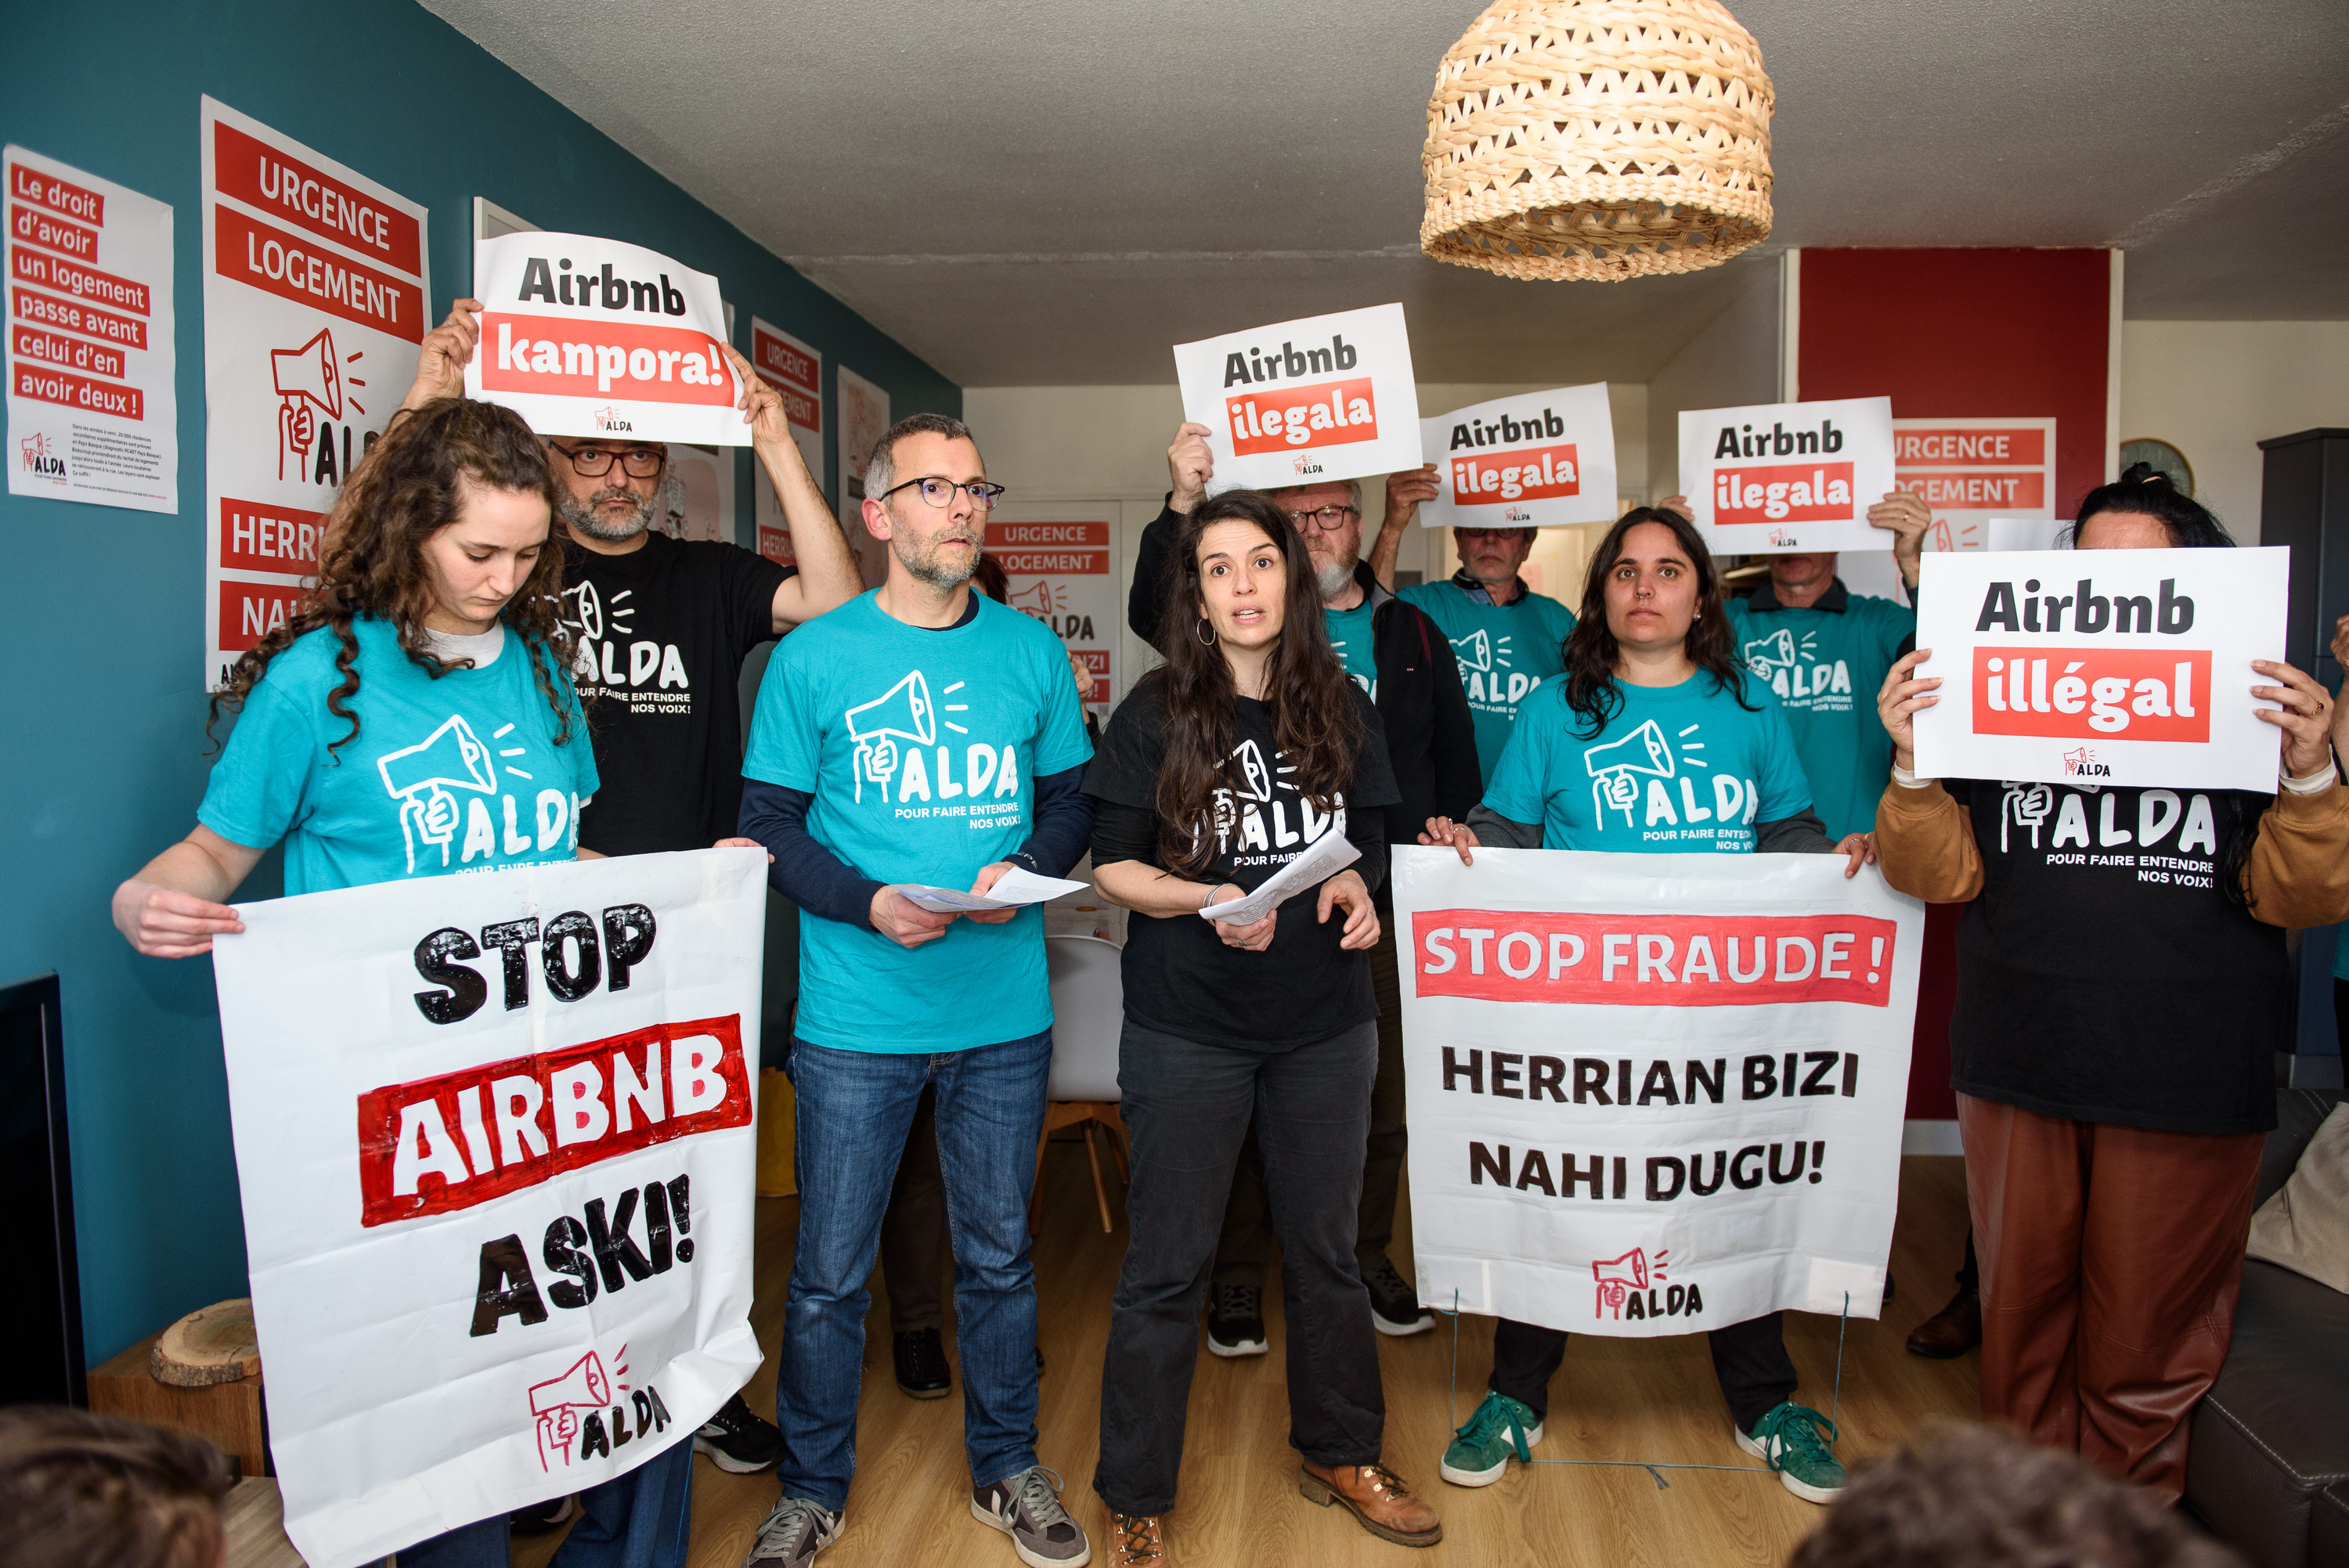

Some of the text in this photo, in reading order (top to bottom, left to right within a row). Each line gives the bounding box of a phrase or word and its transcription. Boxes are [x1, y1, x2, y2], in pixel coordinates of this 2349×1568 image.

[18, 171, 96, 219] Le droit
[259, 156, 389, 251] URGENCE
[18, 212, 90, 254] d'avoir
[20, 255, 144, 308] un logement
[247, 232, 400, 323] LOGEMENT
[518, 257, 686, 316] Airbnb
[20, 294, 139, 343] passe avant
[20, 335, 117, 373] celui d'en
[498, 323, 723, 391] kanpora!
[767, 341, 808, 381] URGENCE
[1224, 334, 1357, 388] Airbnb
[21, 374, 136, 414] avoir deux !
[770, 385, 811, 421] EMENT
[606, 420, 632, 431] ALDA
[1231, 388, 1373, 445] ilegala
[1450, 407, 1564, 451] Airbnb
[72, 447, 91, 456] Beaucoup
[1715, 419, 1842, 459] Airbnb
[35, 456, 66, 476] ALDA
[1303, 464, 1323, 474] ALDA
[1455, 452, 1576, 499] ilegala
[1717, 470, 1850, 519] ilegala
[1895, 479, 2019, 502] GEMENT
[763, 532, 794, 558] HERRI
[1005, 526, 1086, 542] URGENCE
[1777, 538, 1798, 546] ALDA
[1975, 578, 2194, 635] Airbnb
[572, 636, 688, 690] ALDA
[1073, 654, 1104, 669] IZI
[1771, 660, 1852, 698] ALDA
[575, 687, 691, 702] OUR FAIRE ENTENDRE
[631, 704, 691, 714] NOS VOIX!
[1812, 703, 1829, 712] NOS
[1813, 695, 1853, 704] ENTENDRE
[1987, 657, 2195, 733] illégal
[899, 743, 1018, 803] ALDA
[2077, 764, 2110, 777] ALDA
[895, 802, 1019, 819] POUR FAIRE ENTENDRE
[1646, 774, 1759, 827] ALDA
[970, 815, 1020, 829] NOS VOIX!
[1643, 831, 1677, 841] POUR
[1681, 829, 1715, 839] FAIRE
[2052, 789, 2216, 855] ALDA
[1234, 856, 1267, 867] POUR
[1716, 841, 1740, 850] NOS
[2046, 854, 2214, 873] POUR FAIRE ENTENDRE
[2138, 871, 2213, 888] NOS VOIX!
[413, 903, 655, 1025] STOP
[1423, 928, 1884, 985] STOP FRAUDE !
[1441, 1045, 1858, 1106] HERRIAN BIZI
[393, 1033, 727, 1197] AIRBNB
[1469, 1141, 1825, 1201] NAHI DUGU!
[469, 1174, 695, 1337] ASKI!
[1626, 1283, 1703, 1320] ALDA
[580, 1386, 671, 1459] ALDA
